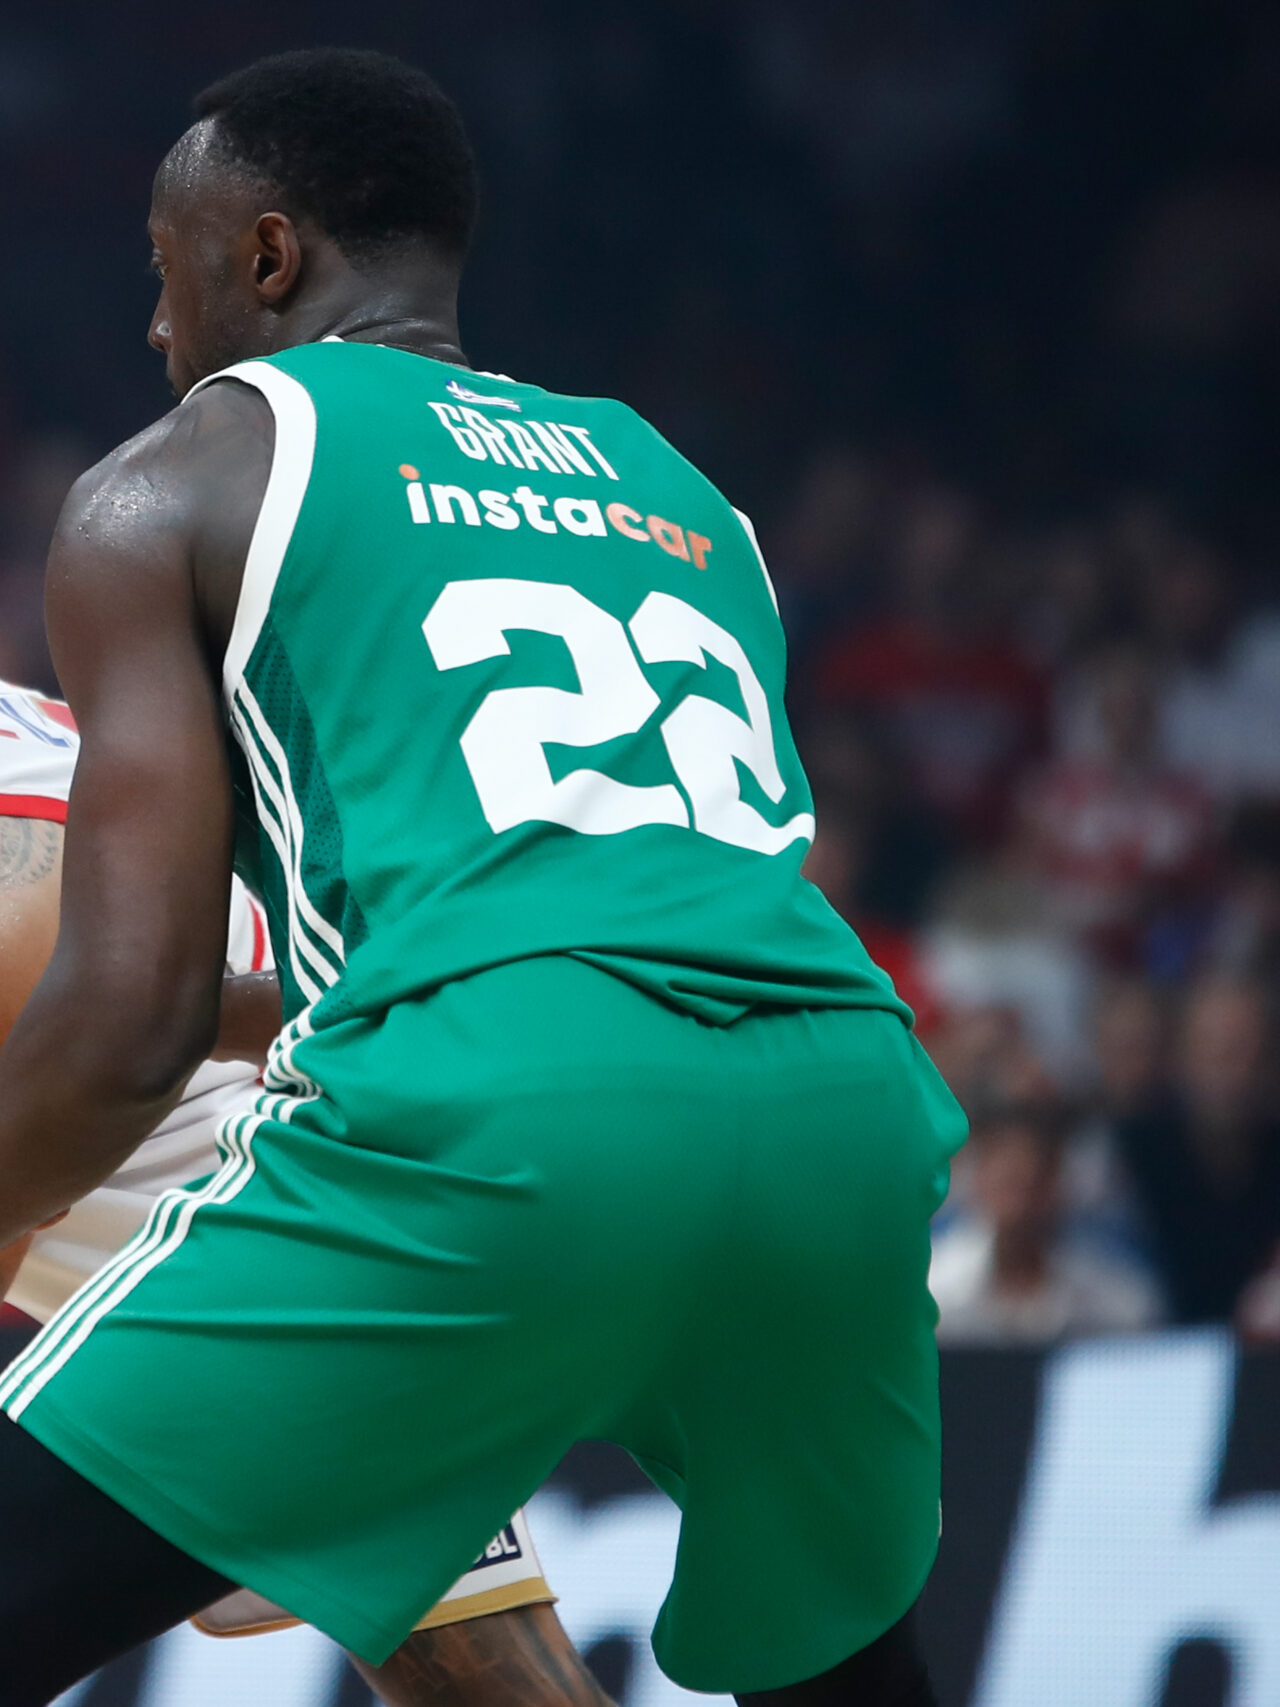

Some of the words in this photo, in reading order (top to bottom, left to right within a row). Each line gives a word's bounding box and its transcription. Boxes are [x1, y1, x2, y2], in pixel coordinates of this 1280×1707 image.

[427, 402, 620, 480] GRANT
[399, 464, 713, 571] instacar
[421, 578, 816, 856] 22
[473, 1529, 518, 1563] BL
